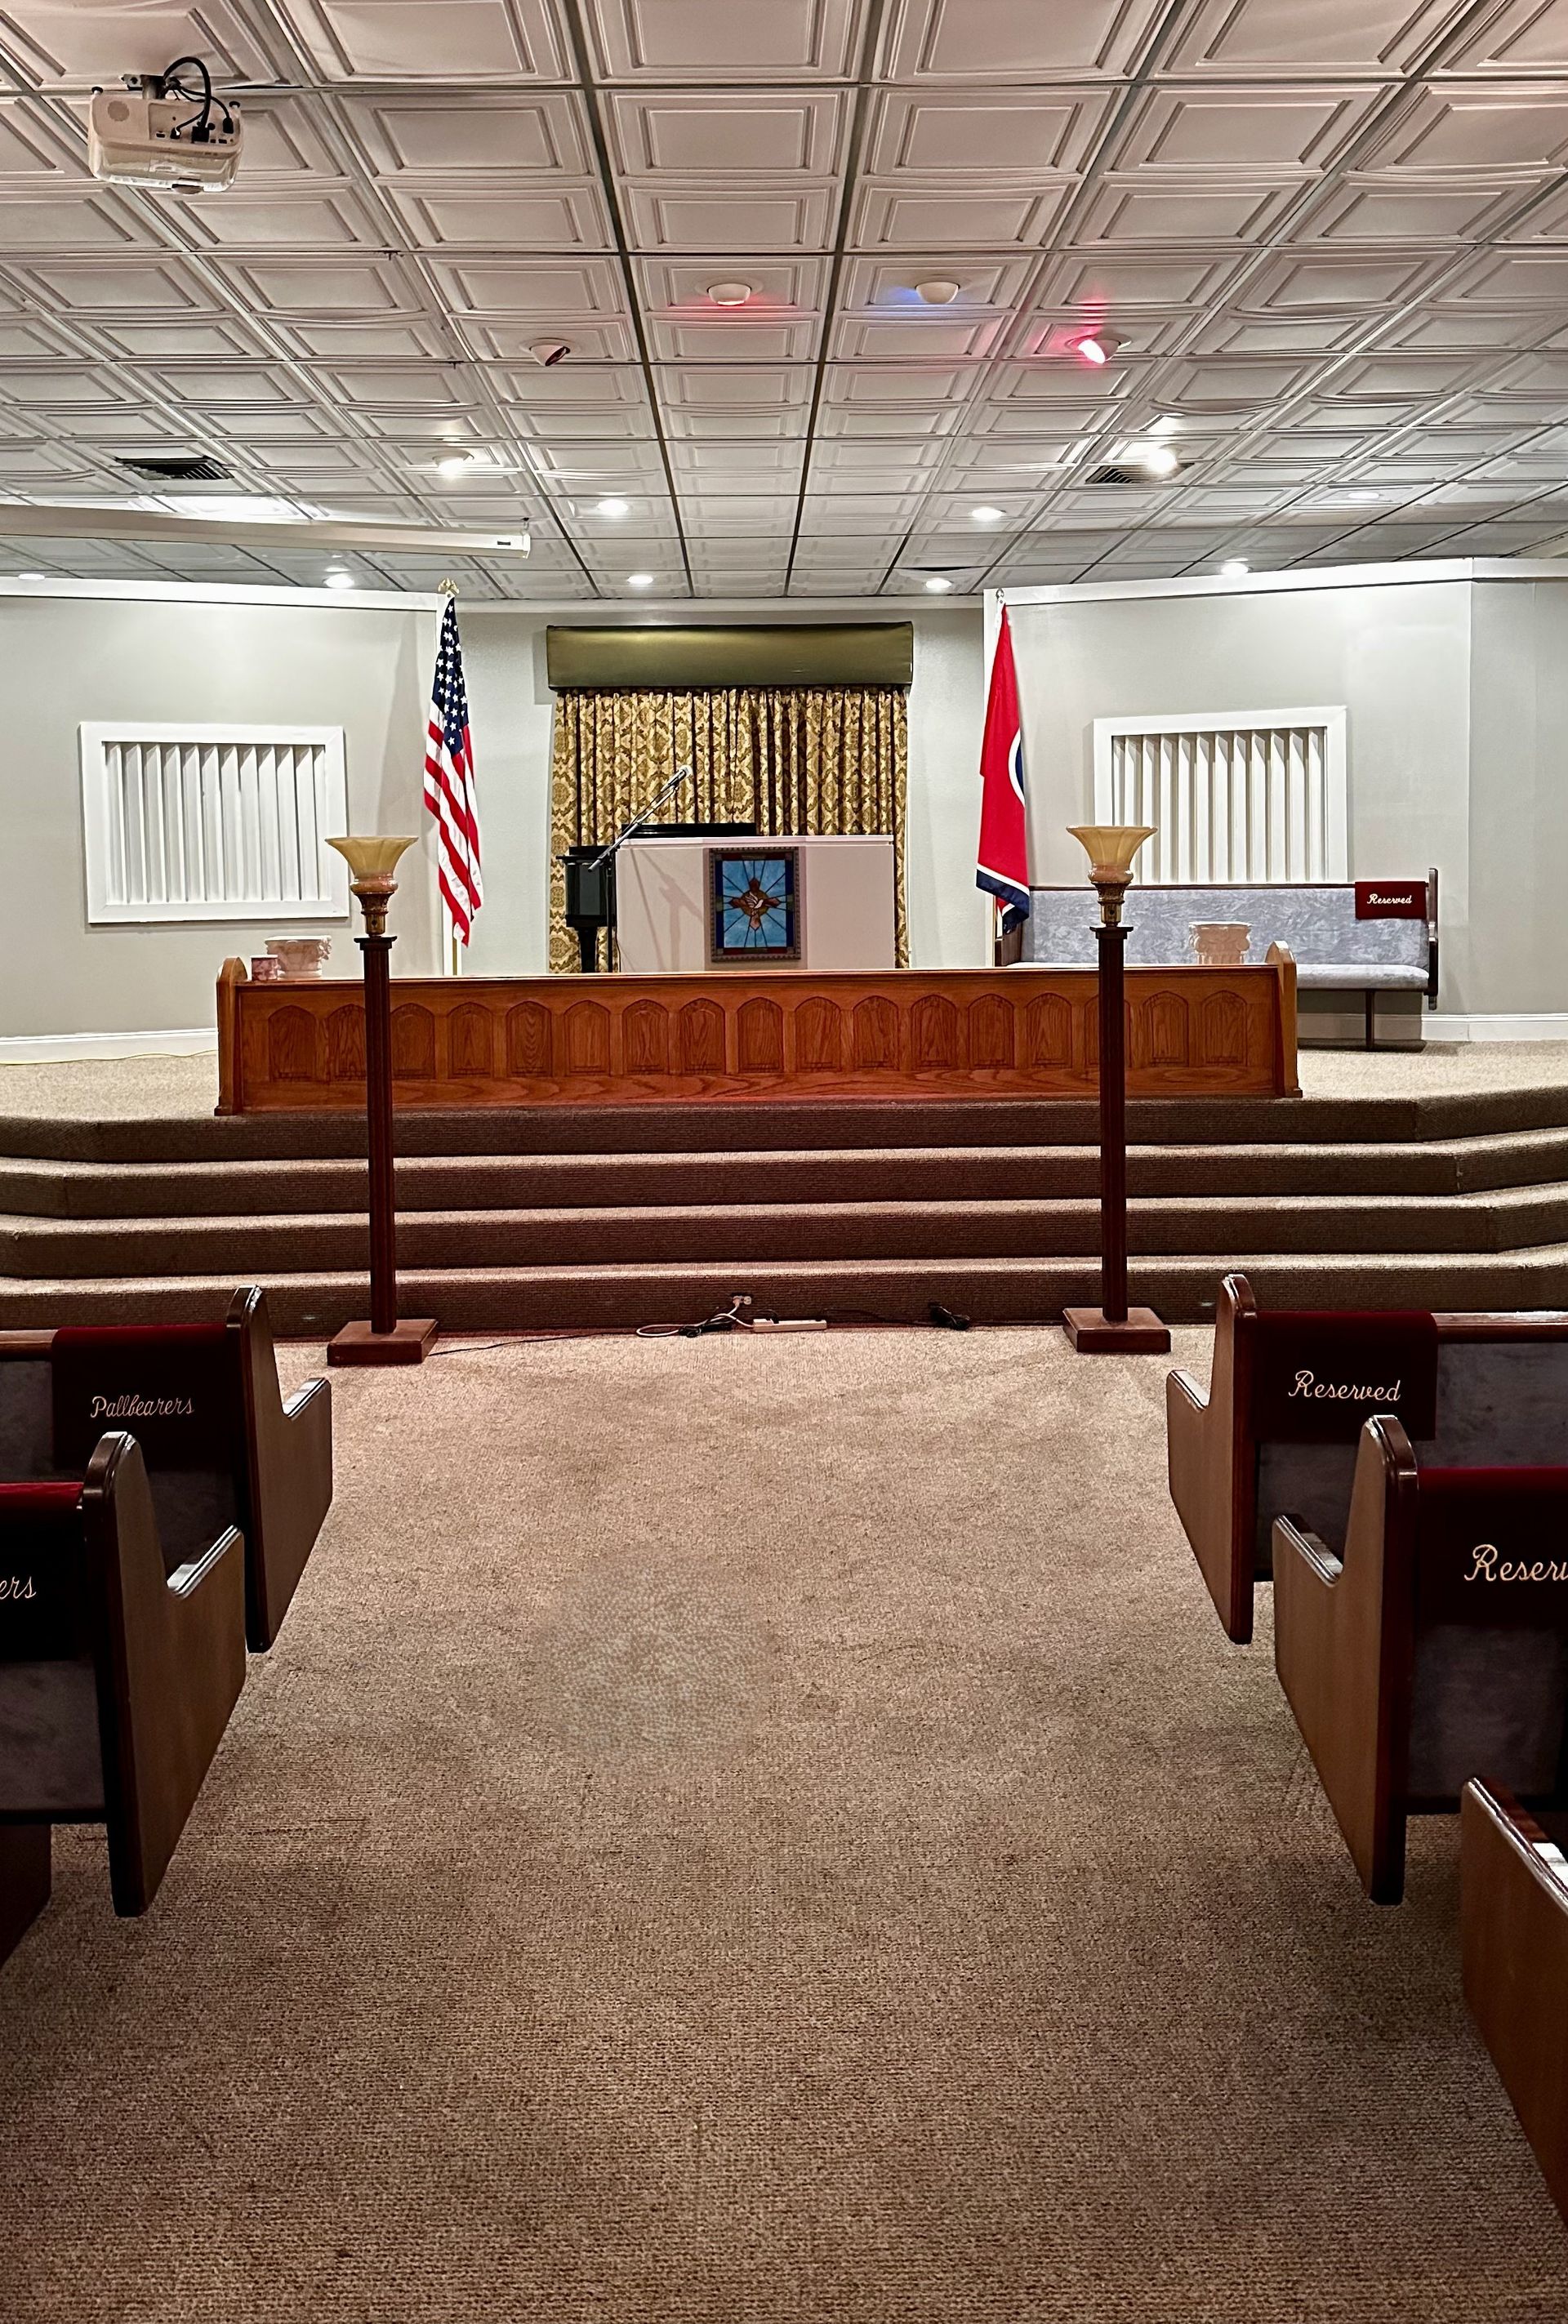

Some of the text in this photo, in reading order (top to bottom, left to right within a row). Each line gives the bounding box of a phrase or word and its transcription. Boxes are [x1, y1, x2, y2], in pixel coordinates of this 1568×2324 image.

[1366, 893, 1413, 905] Reserved
[1288, 1369, 1401, 1401] Reserved
[90, 1394, 195, 1418] Pallbearers
[0, 1576, 37, 1600] ers
